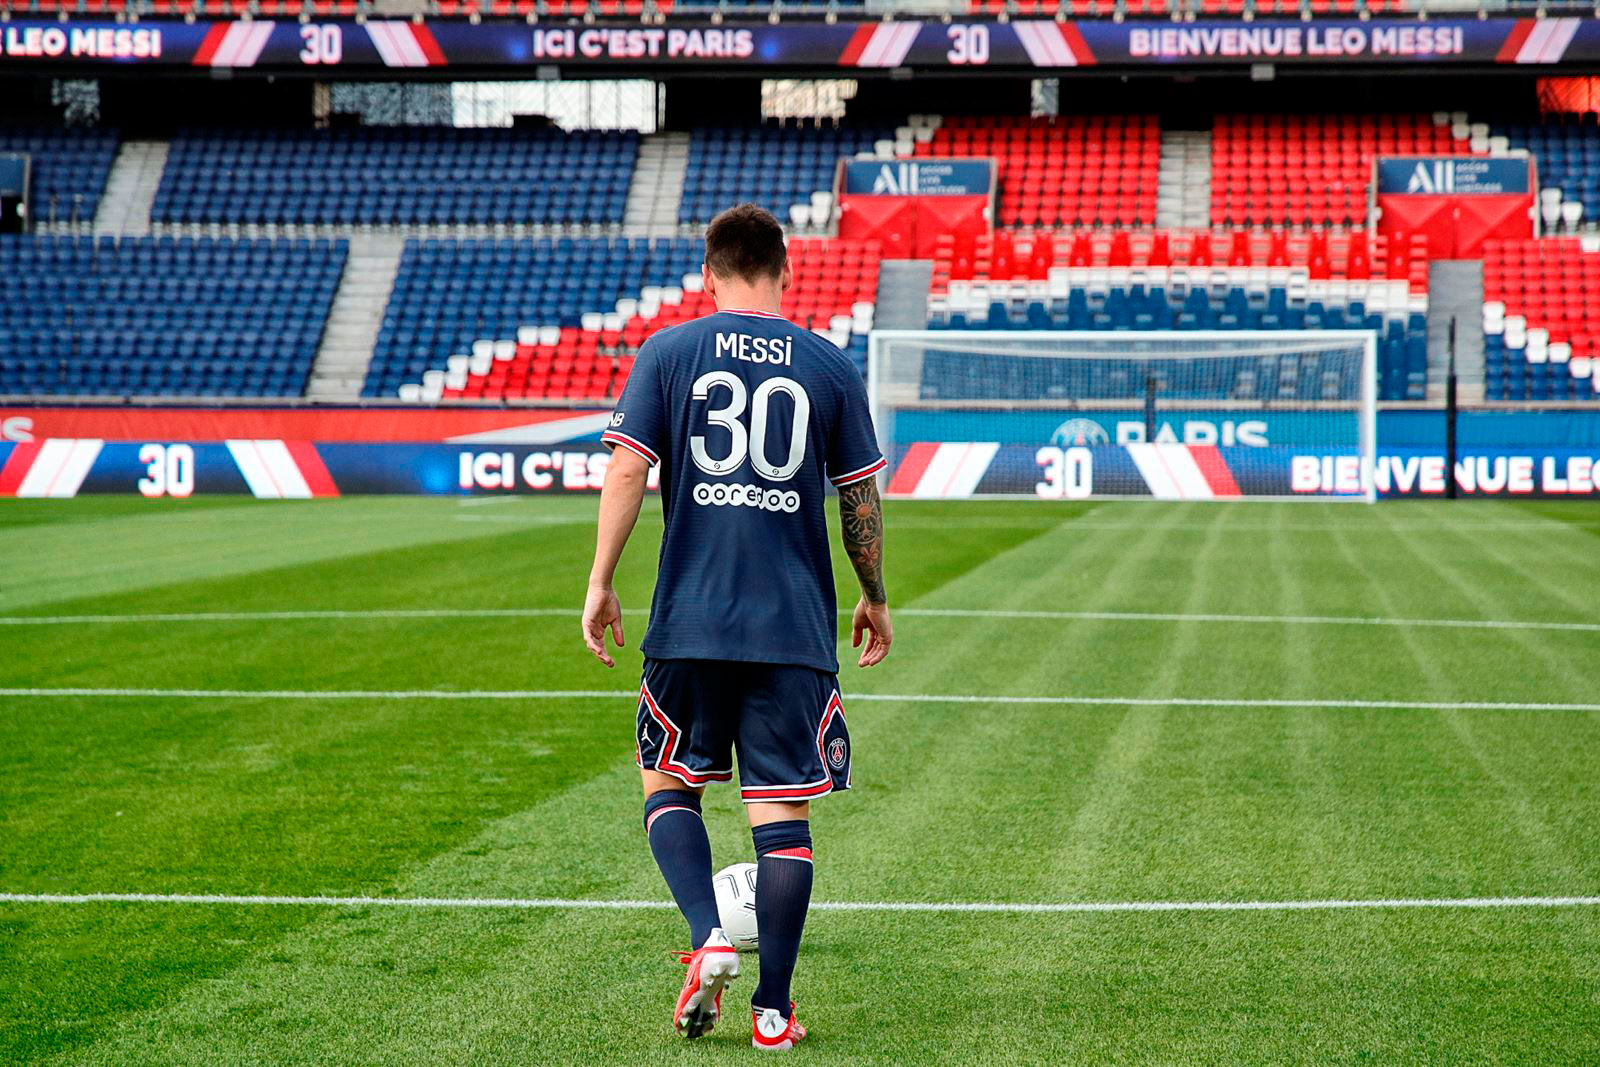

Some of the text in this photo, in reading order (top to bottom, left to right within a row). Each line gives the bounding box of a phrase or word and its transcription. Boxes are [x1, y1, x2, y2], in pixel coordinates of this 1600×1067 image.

[6, 27, 67, 56] LEO
[70, 28, 161, 57] MESSI
[300, 24, 342, 64] 30
[533, 29, 754, 57] ICI C'EST PARIS
[946, 24, 990, 64] 30
[1129, 26, 1463, 56] BIENVENUE LEO MESSI
[690, 370, 810, 482] 30
[138, 443, 194, 497] 30
[459, 452, 515, 489] ICI
[1035, 446, 1093, 498] 30
[1291, 455, 1534, 493] BIENVENUE
